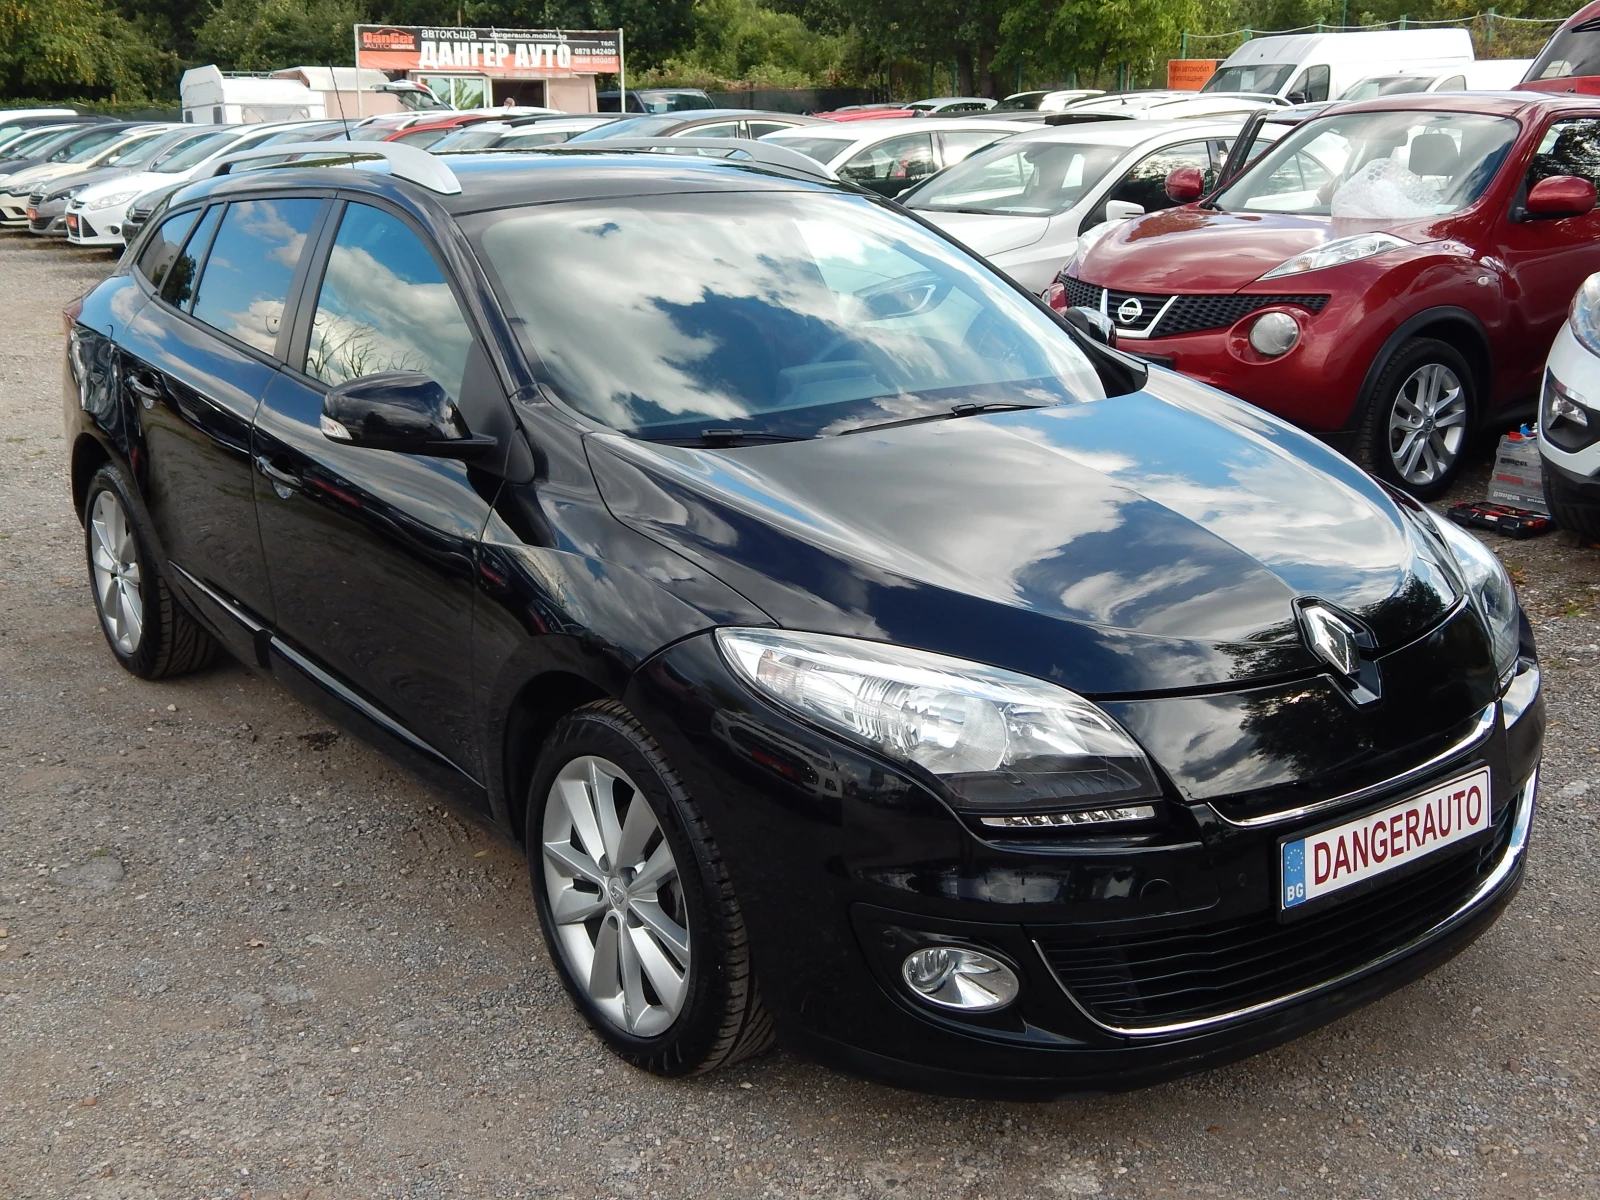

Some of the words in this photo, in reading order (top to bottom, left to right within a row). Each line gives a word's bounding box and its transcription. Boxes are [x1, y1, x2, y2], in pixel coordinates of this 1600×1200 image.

[363, 32, 414, 44] DanGer
[421, 29, 477, 40] автокъща
[418, 40, 509, 70] ДАНГЕР
[514, 42, 571, 68] АУТО
[1314, 785, 1482, 886] DANGERAUTO
[1287, 882, 1304, 902] BG
